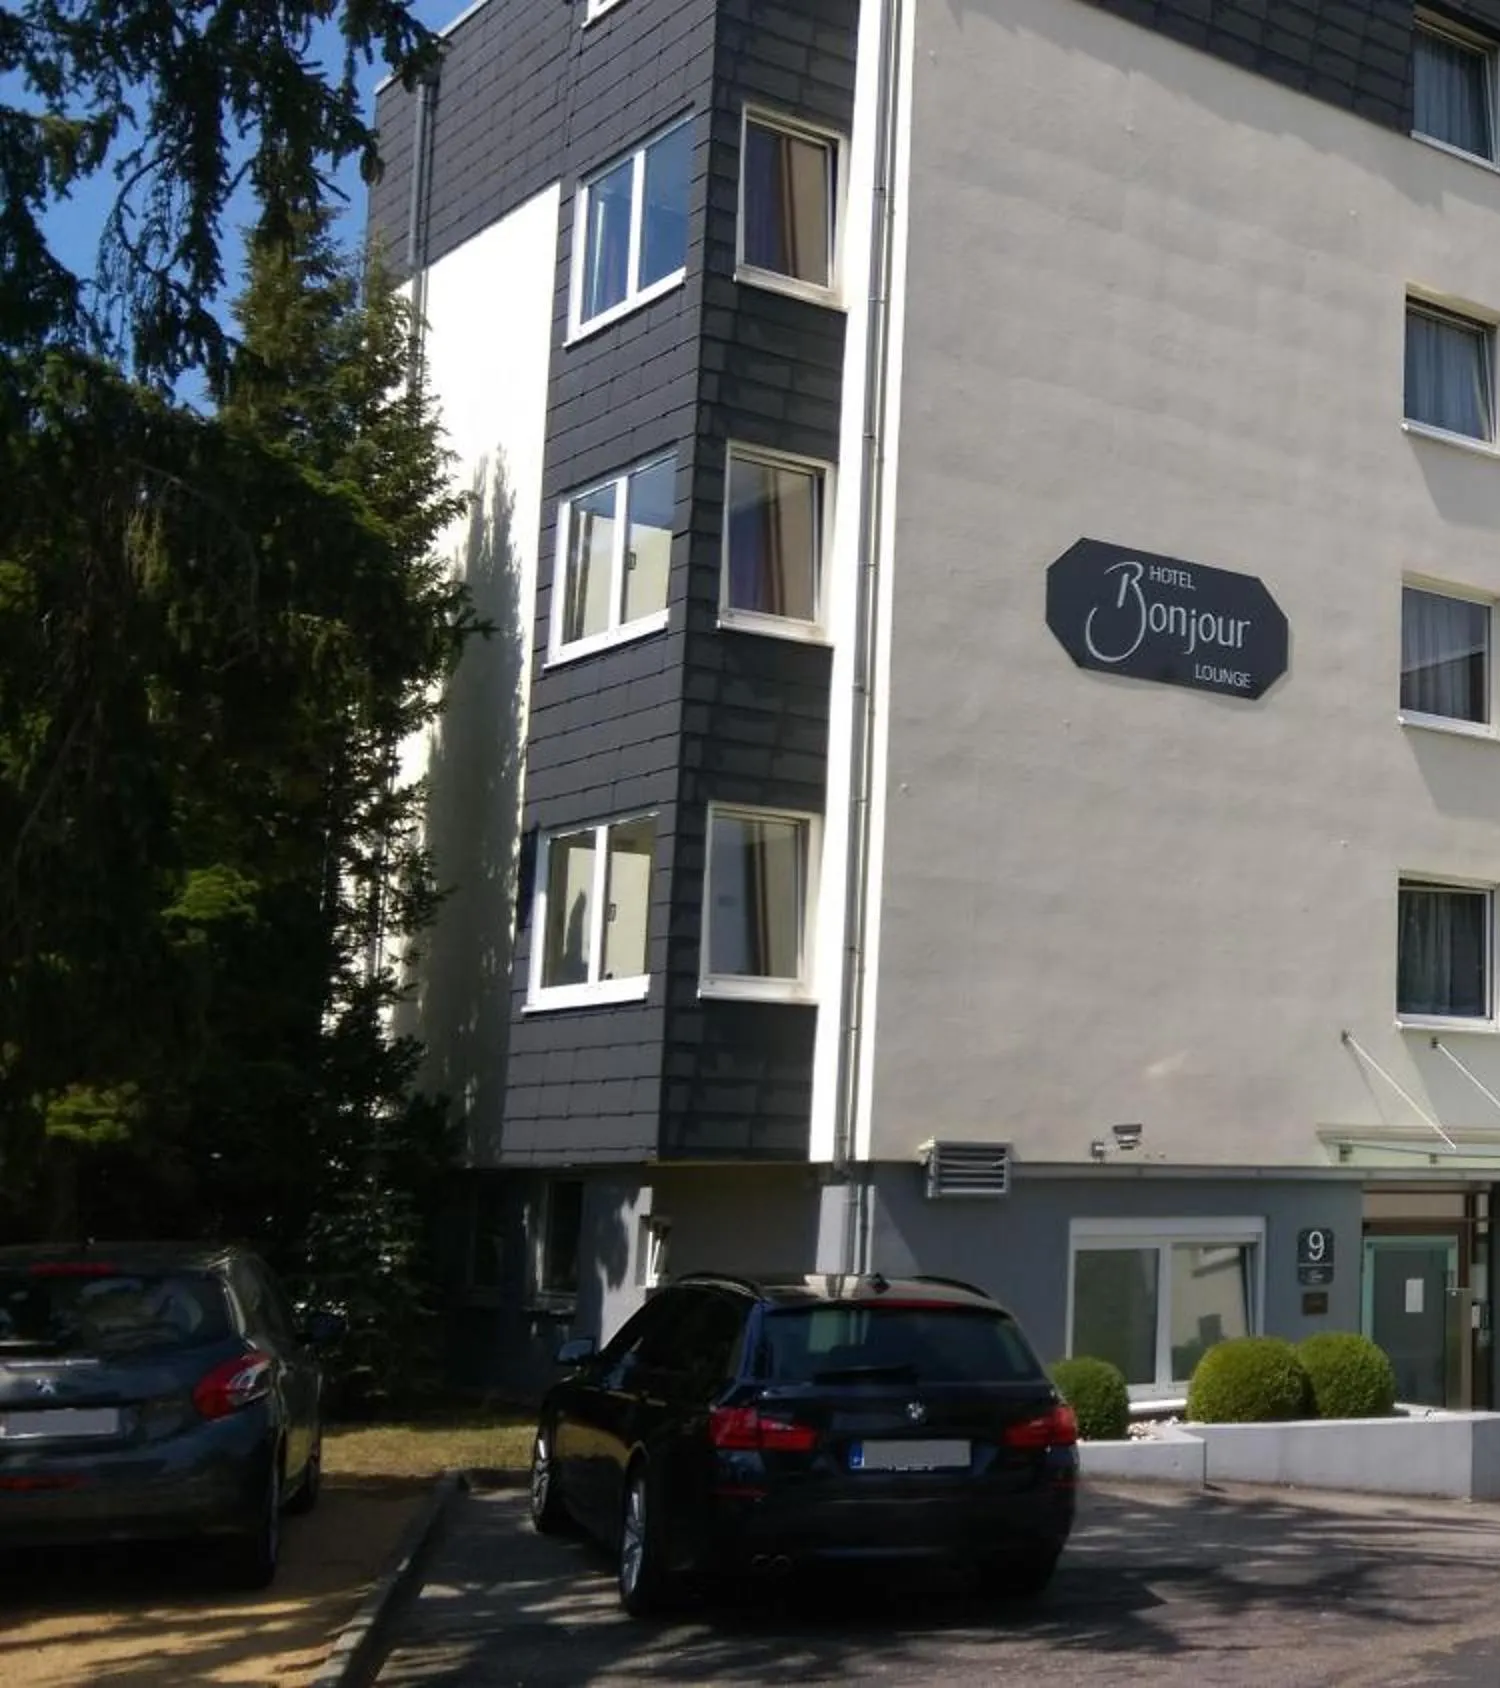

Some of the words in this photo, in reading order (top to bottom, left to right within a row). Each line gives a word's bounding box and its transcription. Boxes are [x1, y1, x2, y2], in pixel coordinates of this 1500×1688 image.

[1150, 565, 1196, 590] HOTEL
[1085, 561, 1251, 663] Bonjour
[1194, 663, 1252, 689] LOUNGE
[1308, 1230, 1325, 1261] 9
